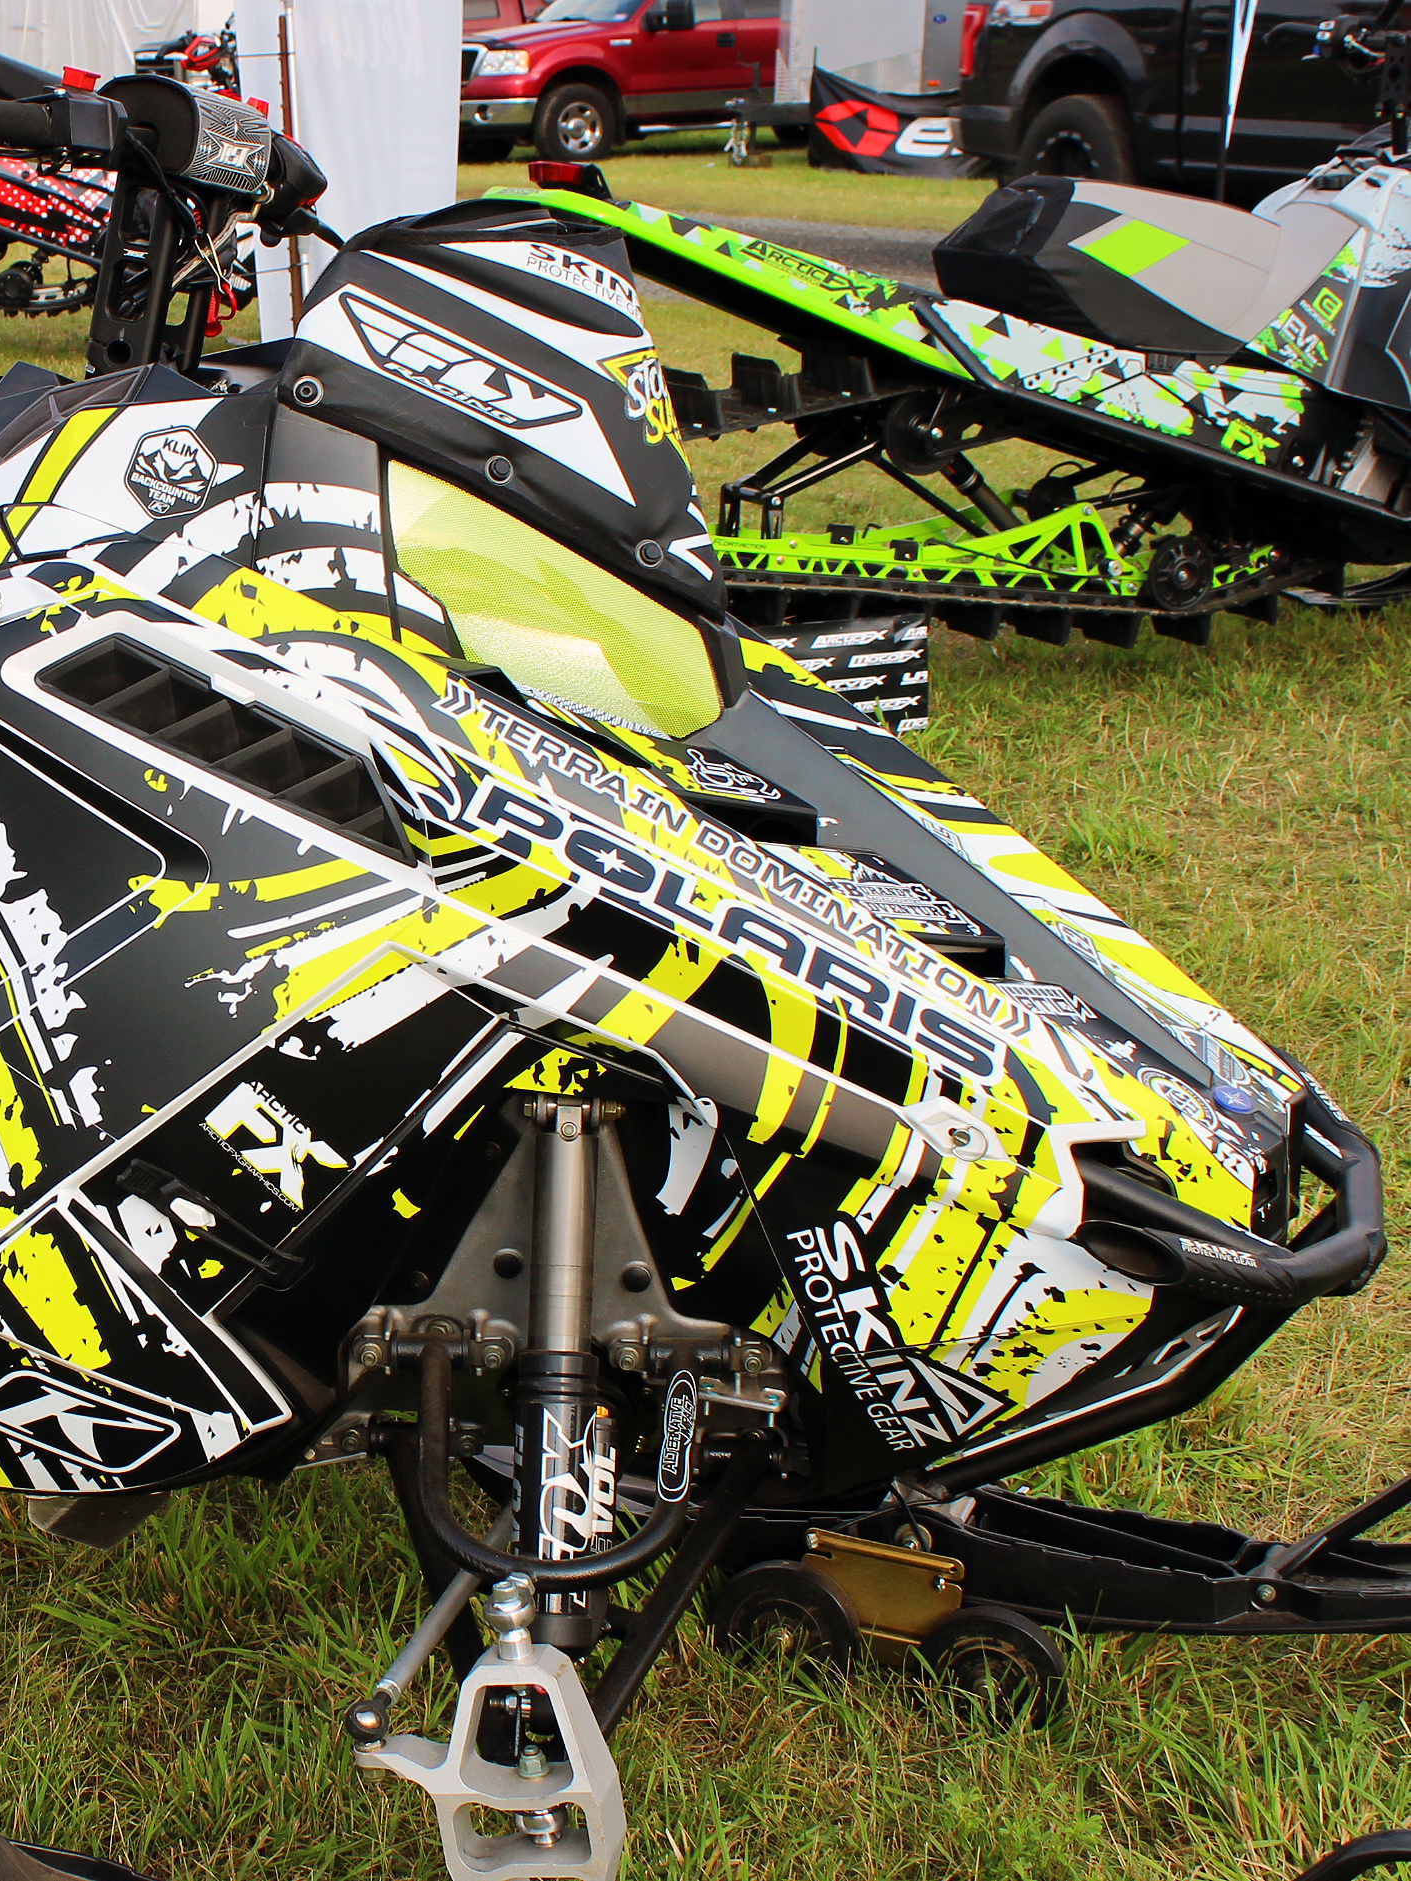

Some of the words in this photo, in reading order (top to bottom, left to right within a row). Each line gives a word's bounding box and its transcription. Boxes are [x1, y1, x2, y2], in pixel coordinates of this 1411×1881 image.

[527, 256, 623, 307] PROTECTIVE
[530, 244, 640, 308] SKIN
[740, 240, 874, 298] ARCTICFX
[163, 438, 198, 460] KLIM
[131, 472, 201, 505] BACKCOUNTRY
[148, 488, 176, 506] TEAM
[810, 629, 889, 649] ARCTICFX
[478, 699, 692, 836] TERRAIN
[691, 821, 1004, 1022] DOMINATION
[469, 778, 1004, 1085] POLARIS
[249, 1081, 309, 1135] ARCTIC
[198, 1122, 300, 1213] ARCTICFXGRAPHICS.COM
[205, 1082, 349, 1210] FX
[1178, 1237, 1253, 1259] SKINZ
[1182, 1245, 1233, 1263] PROTECTIVE
[1233, 1255, 1258, 1268] GEAR
[786, 1229, 884, 1401] PROTECTIVE
[867, 1402, 915, 1451] GEAR
[814, 1221, 952, 1447] SKINZ
